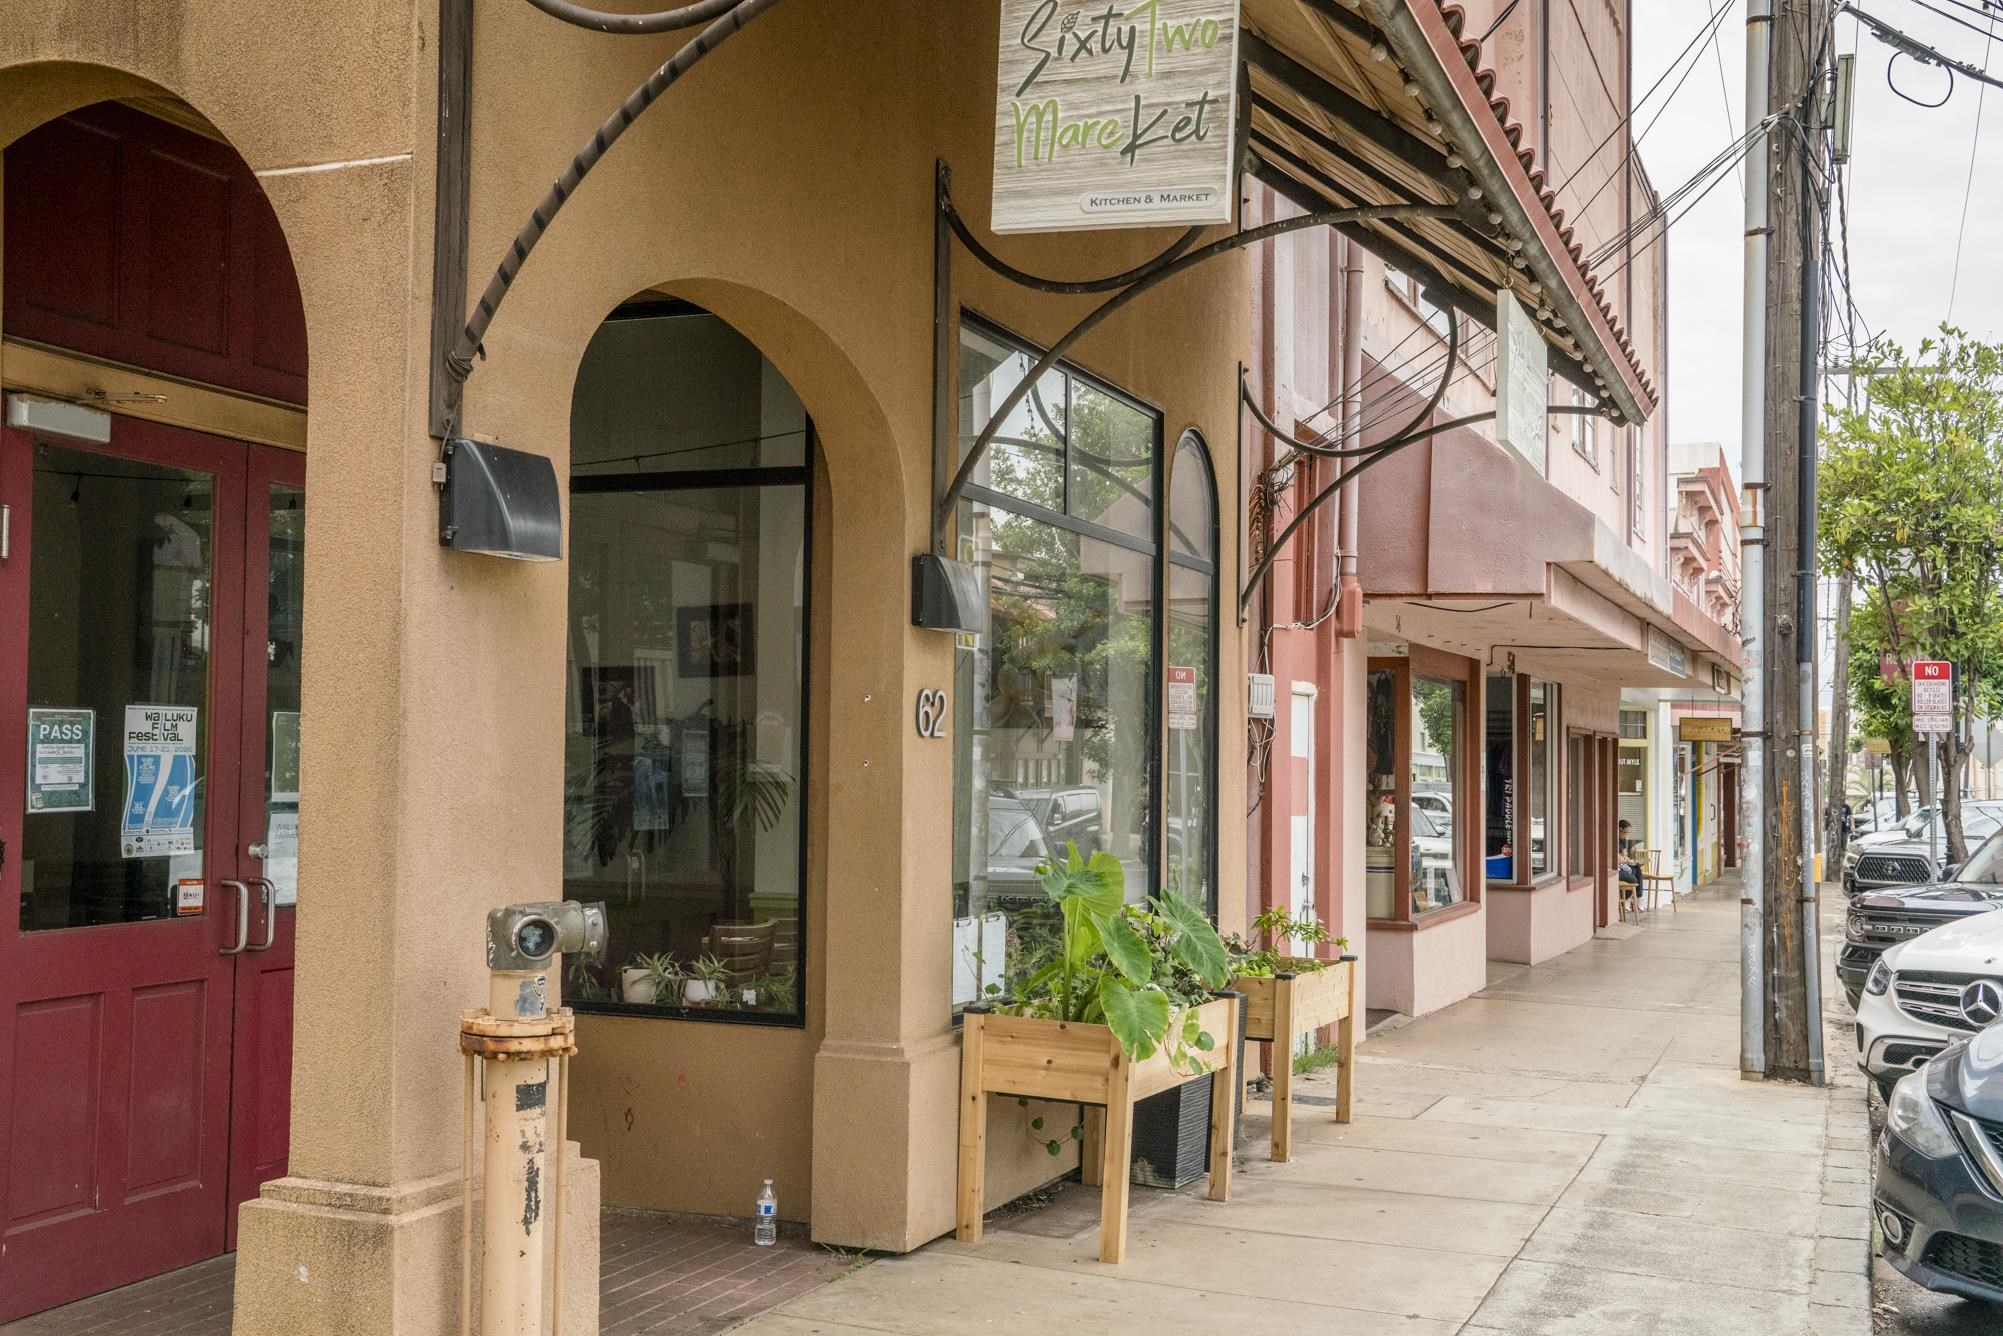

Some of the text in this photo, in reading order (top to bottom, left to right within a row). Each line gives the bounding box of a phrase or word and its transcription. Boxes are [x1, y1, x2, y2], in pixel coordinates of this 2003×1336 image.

[1144, 195, 1154, 204] &
[1925, 665, 1939, 676] NO
[916, 688, 947, 738] 62
[40, 724, 82, 740] PASS
